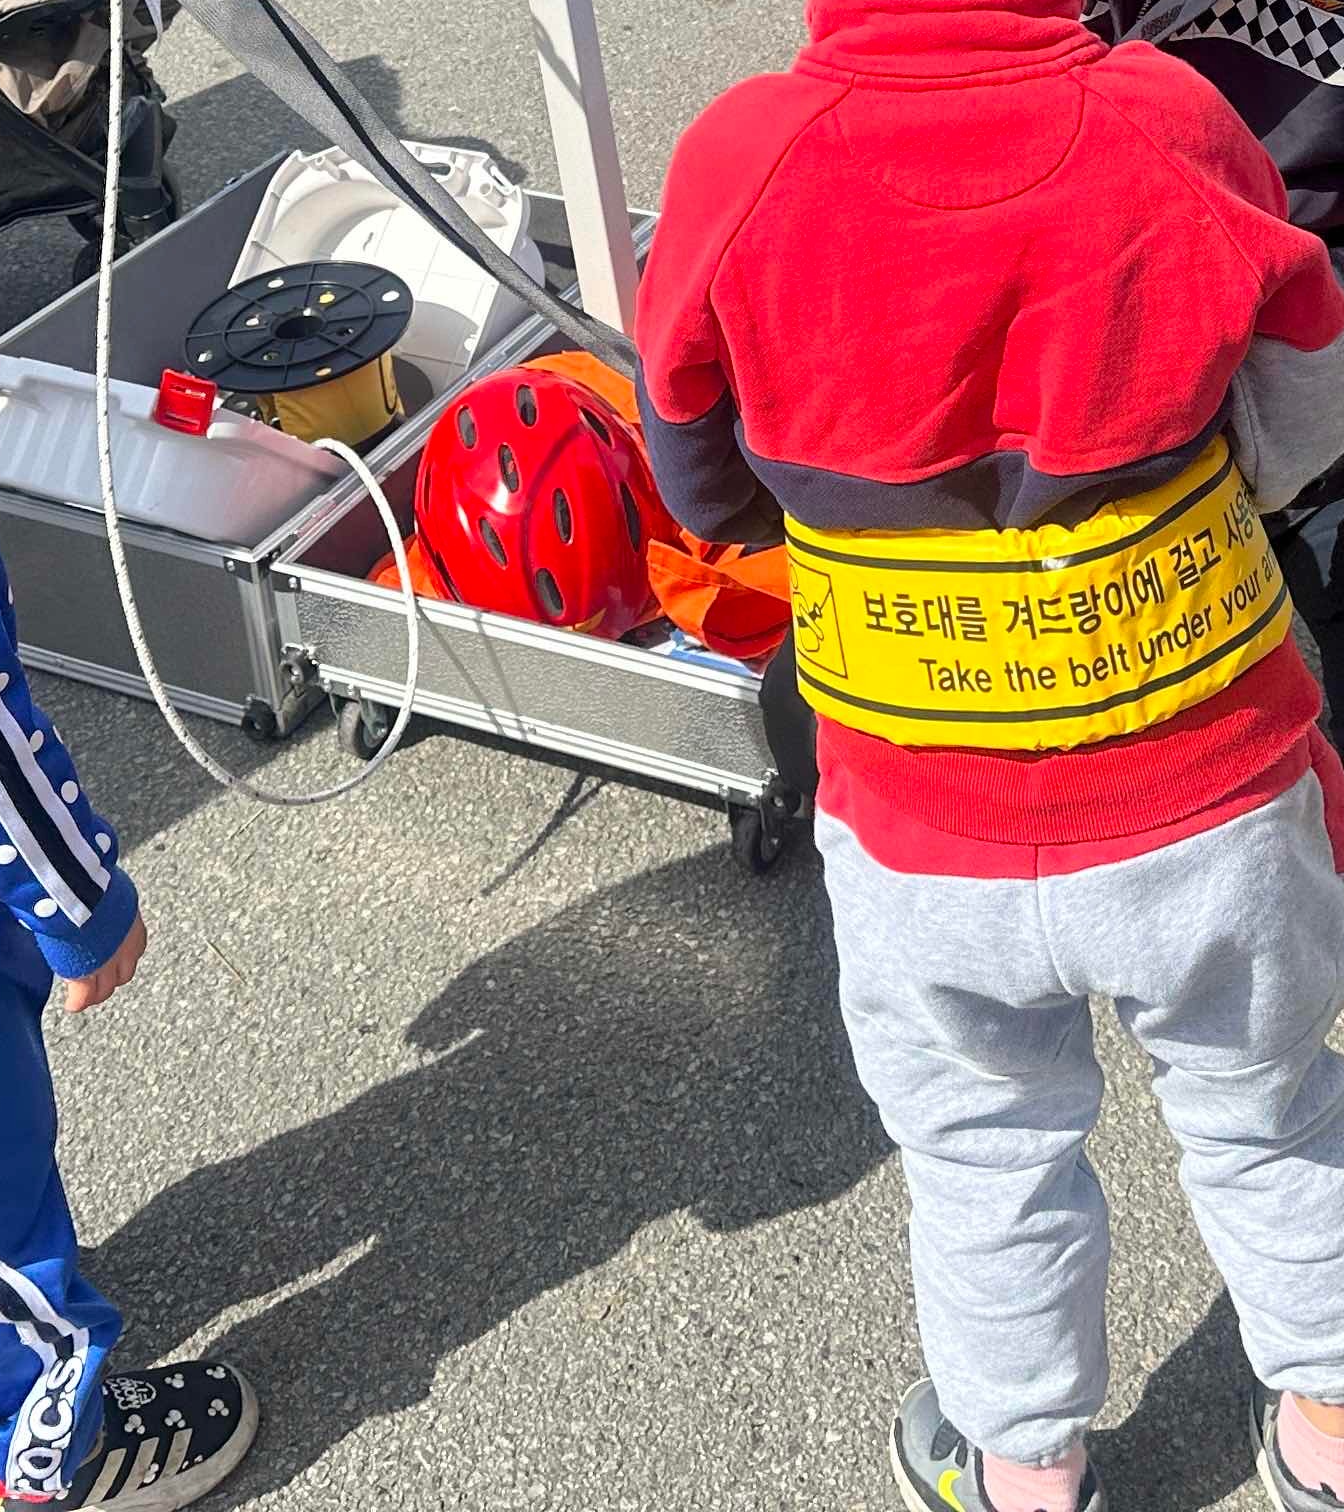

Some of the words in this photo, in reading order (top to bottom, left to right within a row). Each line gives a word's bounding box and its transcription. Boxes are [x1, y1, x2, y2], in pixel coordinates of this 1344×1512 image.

[863, 591, 987, 642] 보호대를
[1003, 557, 1164, 640] 겨드랑이에
[1168, 528, 1221, 591] 걸고
[919, 658, 992, 692] Take
[1005, 661, 1056, 692] the
[1068, 643, 1130, 688] belt
[1139, 603, 1212, 665] under
[1220, 567, 1260, 625] your
